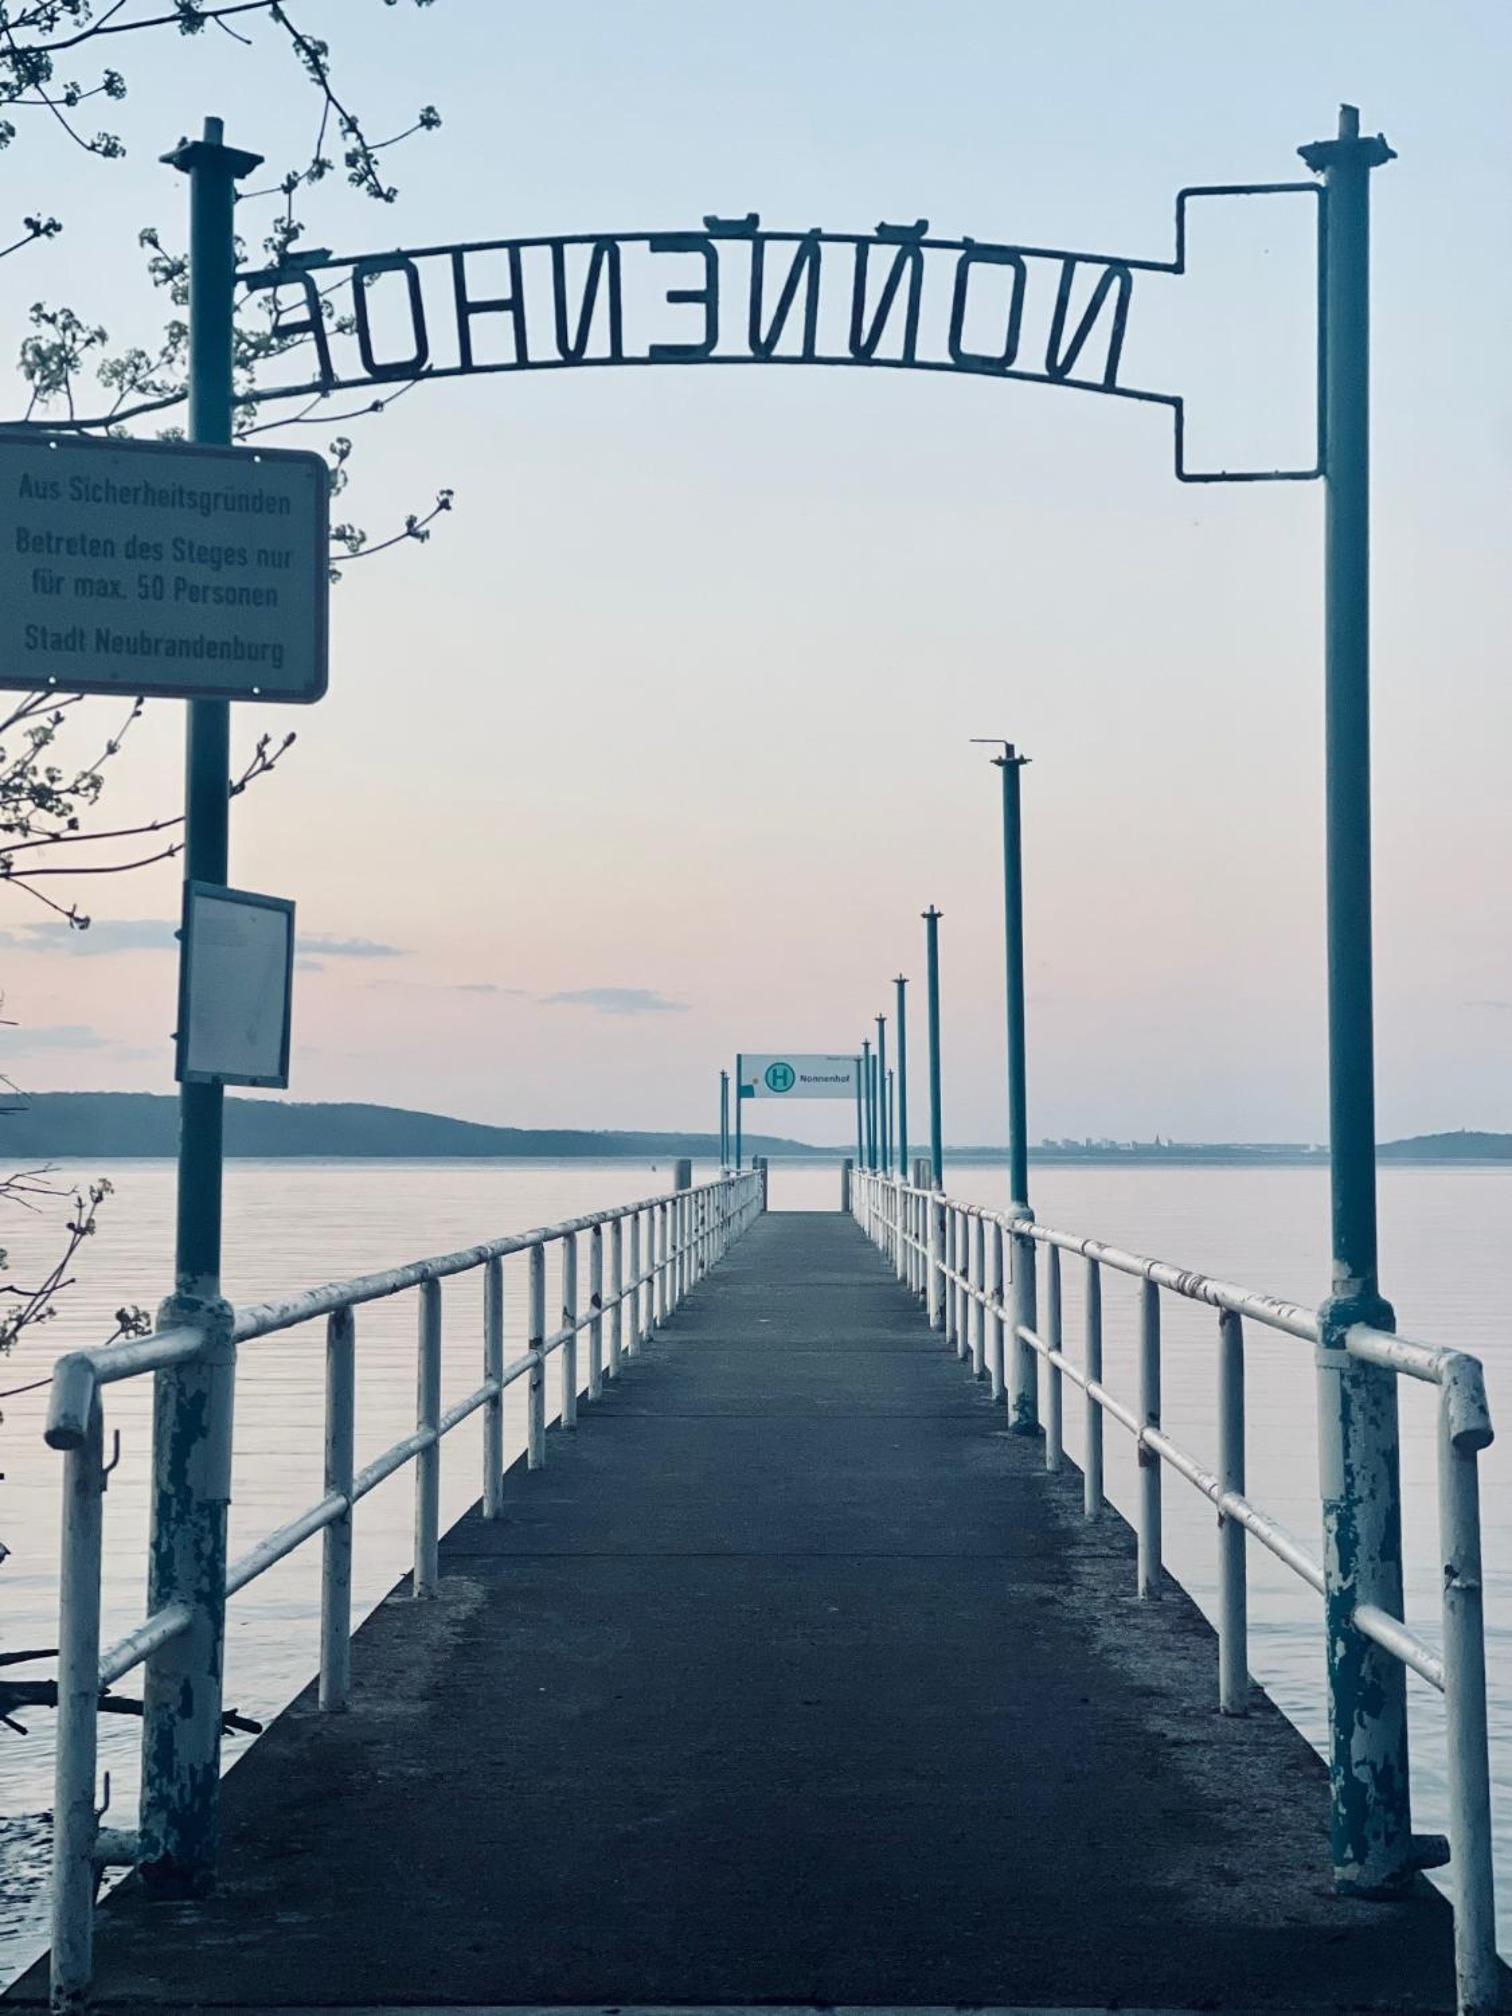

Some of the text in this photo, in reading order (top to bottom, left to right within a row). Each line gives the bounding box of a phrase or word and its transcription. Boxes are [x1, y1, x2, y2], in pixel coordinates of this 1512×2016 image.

[19, 473, 290, 517] Aus Sicherheitsgründen
[16, 527, 291, 571] Betreten des Steges nur
[32, 569, 278, 607] für max. 50 Personen
[25, 624, 284, 669] Stadt Neubrandenburg
[772, 1068, 788, 1087] H
[800, 1074, 850, 1083] Nonnenhof
